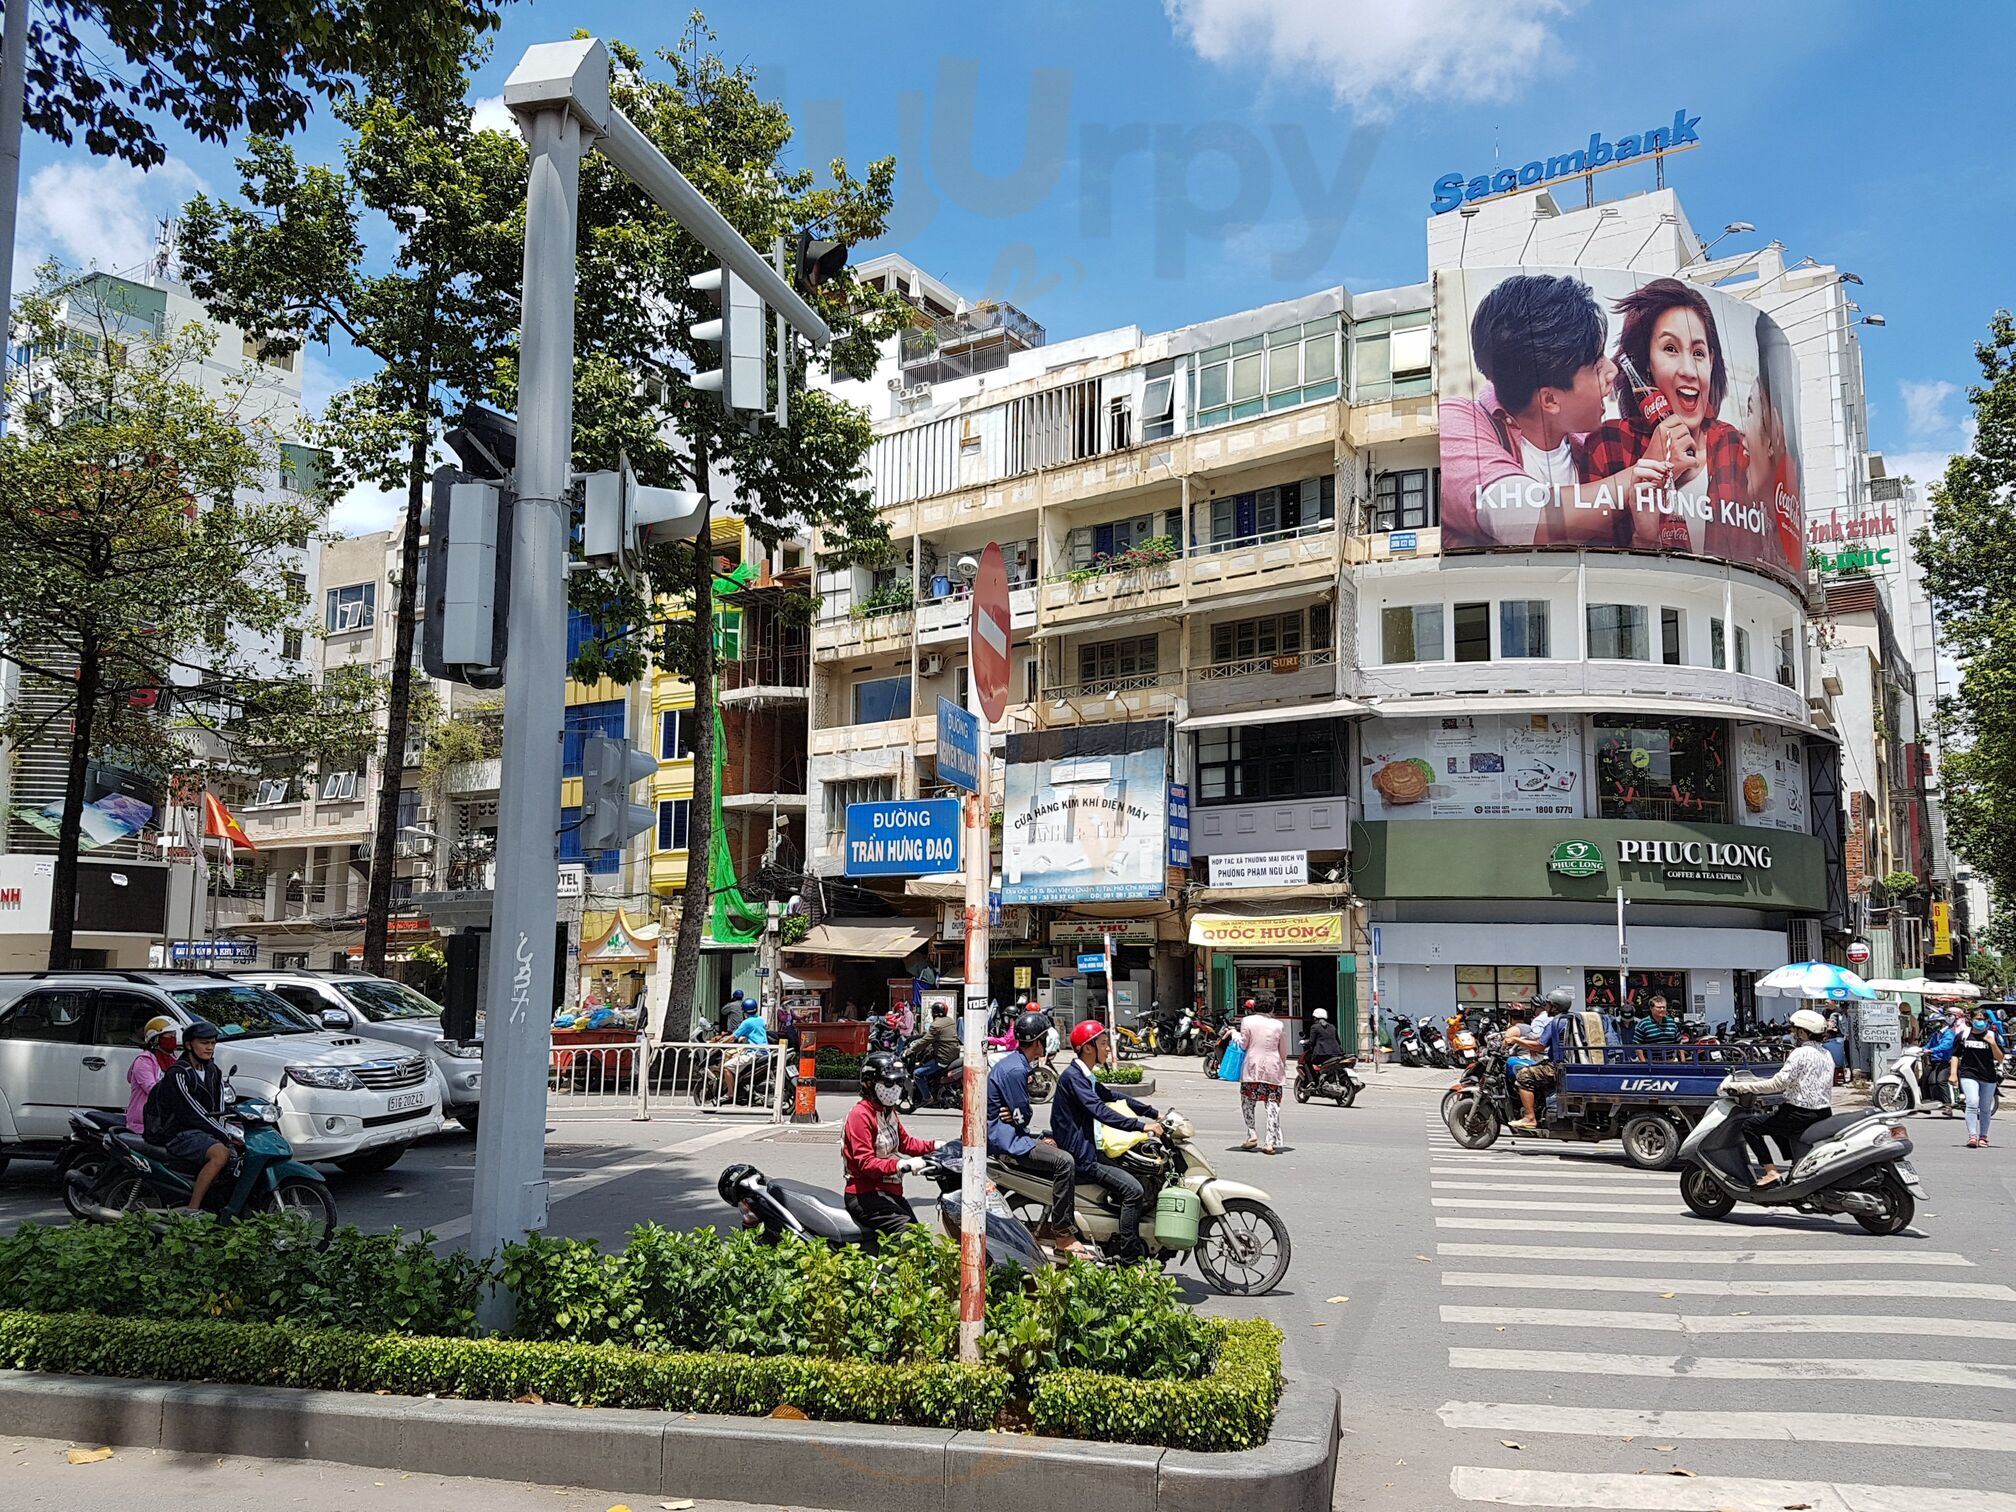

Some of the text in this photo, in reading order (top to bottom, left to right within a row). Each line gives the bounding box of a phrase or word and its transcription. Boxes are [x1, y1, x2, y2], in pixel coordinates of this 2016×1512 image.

[1431, 109, 1701, 214] Sacombank
[1475, 482, 1561, 510] KHƠI
[1573, 482, 1625, 516] LẠI
[1720, 499, 1766, 537] KHỞI
[1272, 656, 1298, 668] SURI
[1014, 795, 1149, 830] CỬA HÀNG KIM KHÍ ĐIỆN MÁY
[1535, 805, 1553, 814] 1800
[873, 808, 931, 828] ĐƯỜNG
[851, 833, 953, 866] TRẦN HƯNG ĐẠO
[1618, 839, 1773, 868] PHUC LONG
[1551, 861, 1604, 870] PHUC LONG
[1667, 870, 1742, 881] COFFEE & TEA EXPRESS
[1074, 925, 1086, 933] A
[1202, 924, 1330, 940] QUỐC HƯƠNG
[1620, 1078, 1680, 1092] LIFAN
